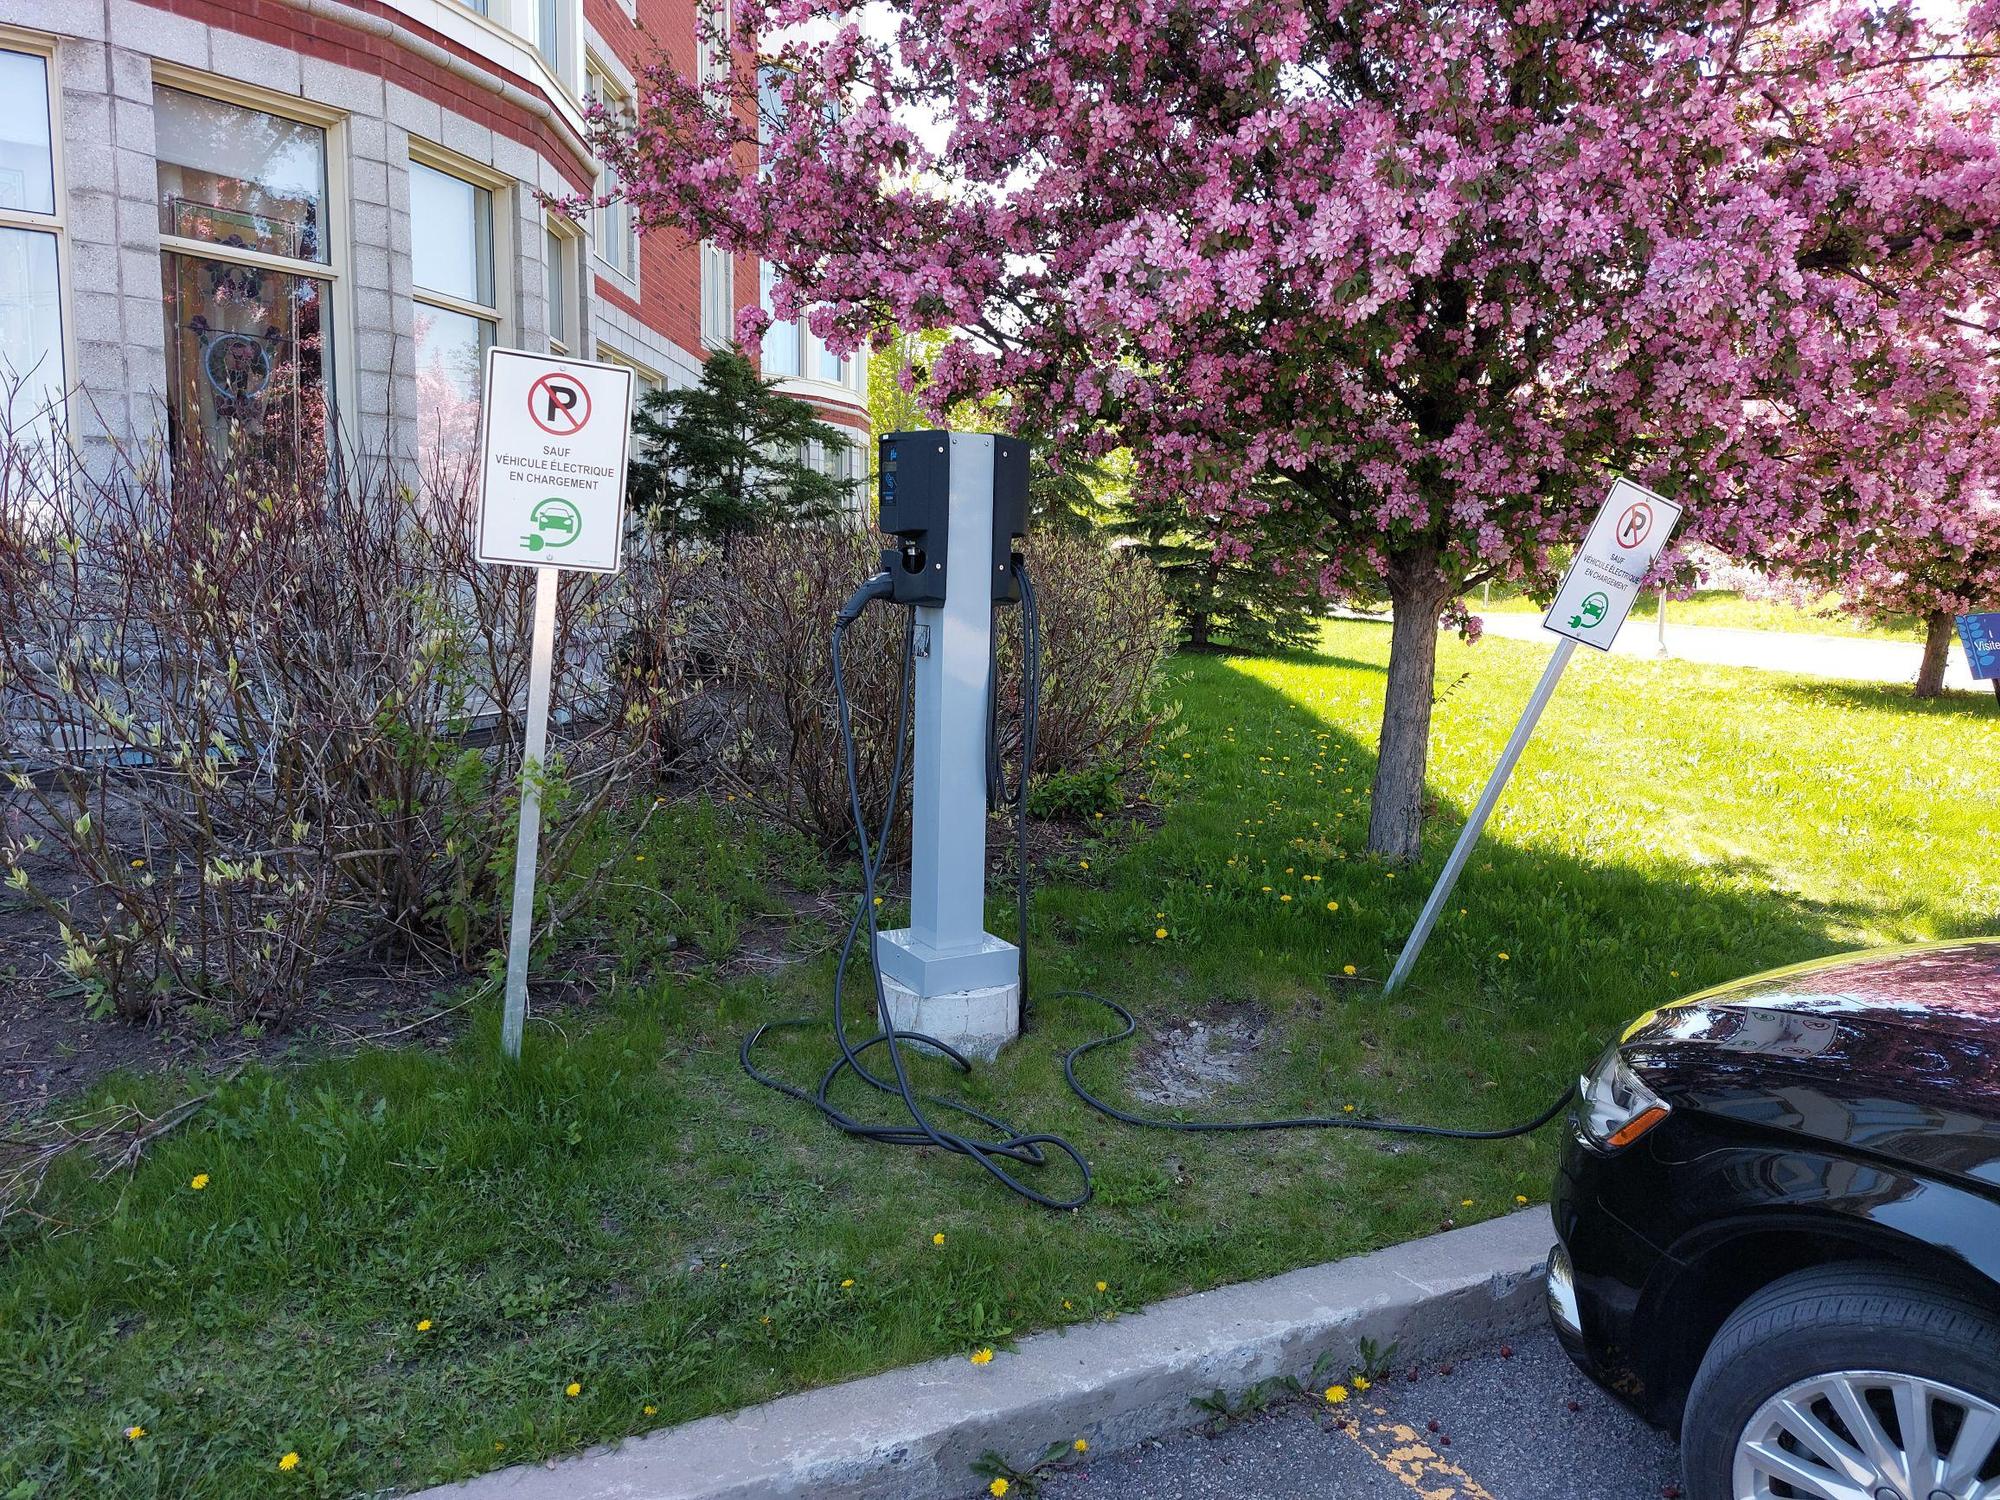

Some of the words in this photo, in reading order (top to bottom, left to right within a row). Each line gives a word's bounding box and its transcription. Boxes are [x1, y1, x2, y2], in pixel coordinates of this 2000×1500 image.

[547, 385, 577, 422] P
[543, 445, 571, 457] SAUF
[495, 453, 548, 470] VÉHICULE
[550, 459, 615, 478] ÉLECTRIQUE
[509, 471, 524, 482] EN
[526, 473, 599, 490] CHARGEMENT
[1623, 511, 1647, 538] P
[1583, 553, 1610, 571] VÉHICULE
[1608, 563, 1641, 585] ÉLECTRIQUE
[1610, 553, 1626, 565] SAUF
[1584, 568, 1594, 577] EN
[1593, 571, 1629, 592] CHARGEMENT
